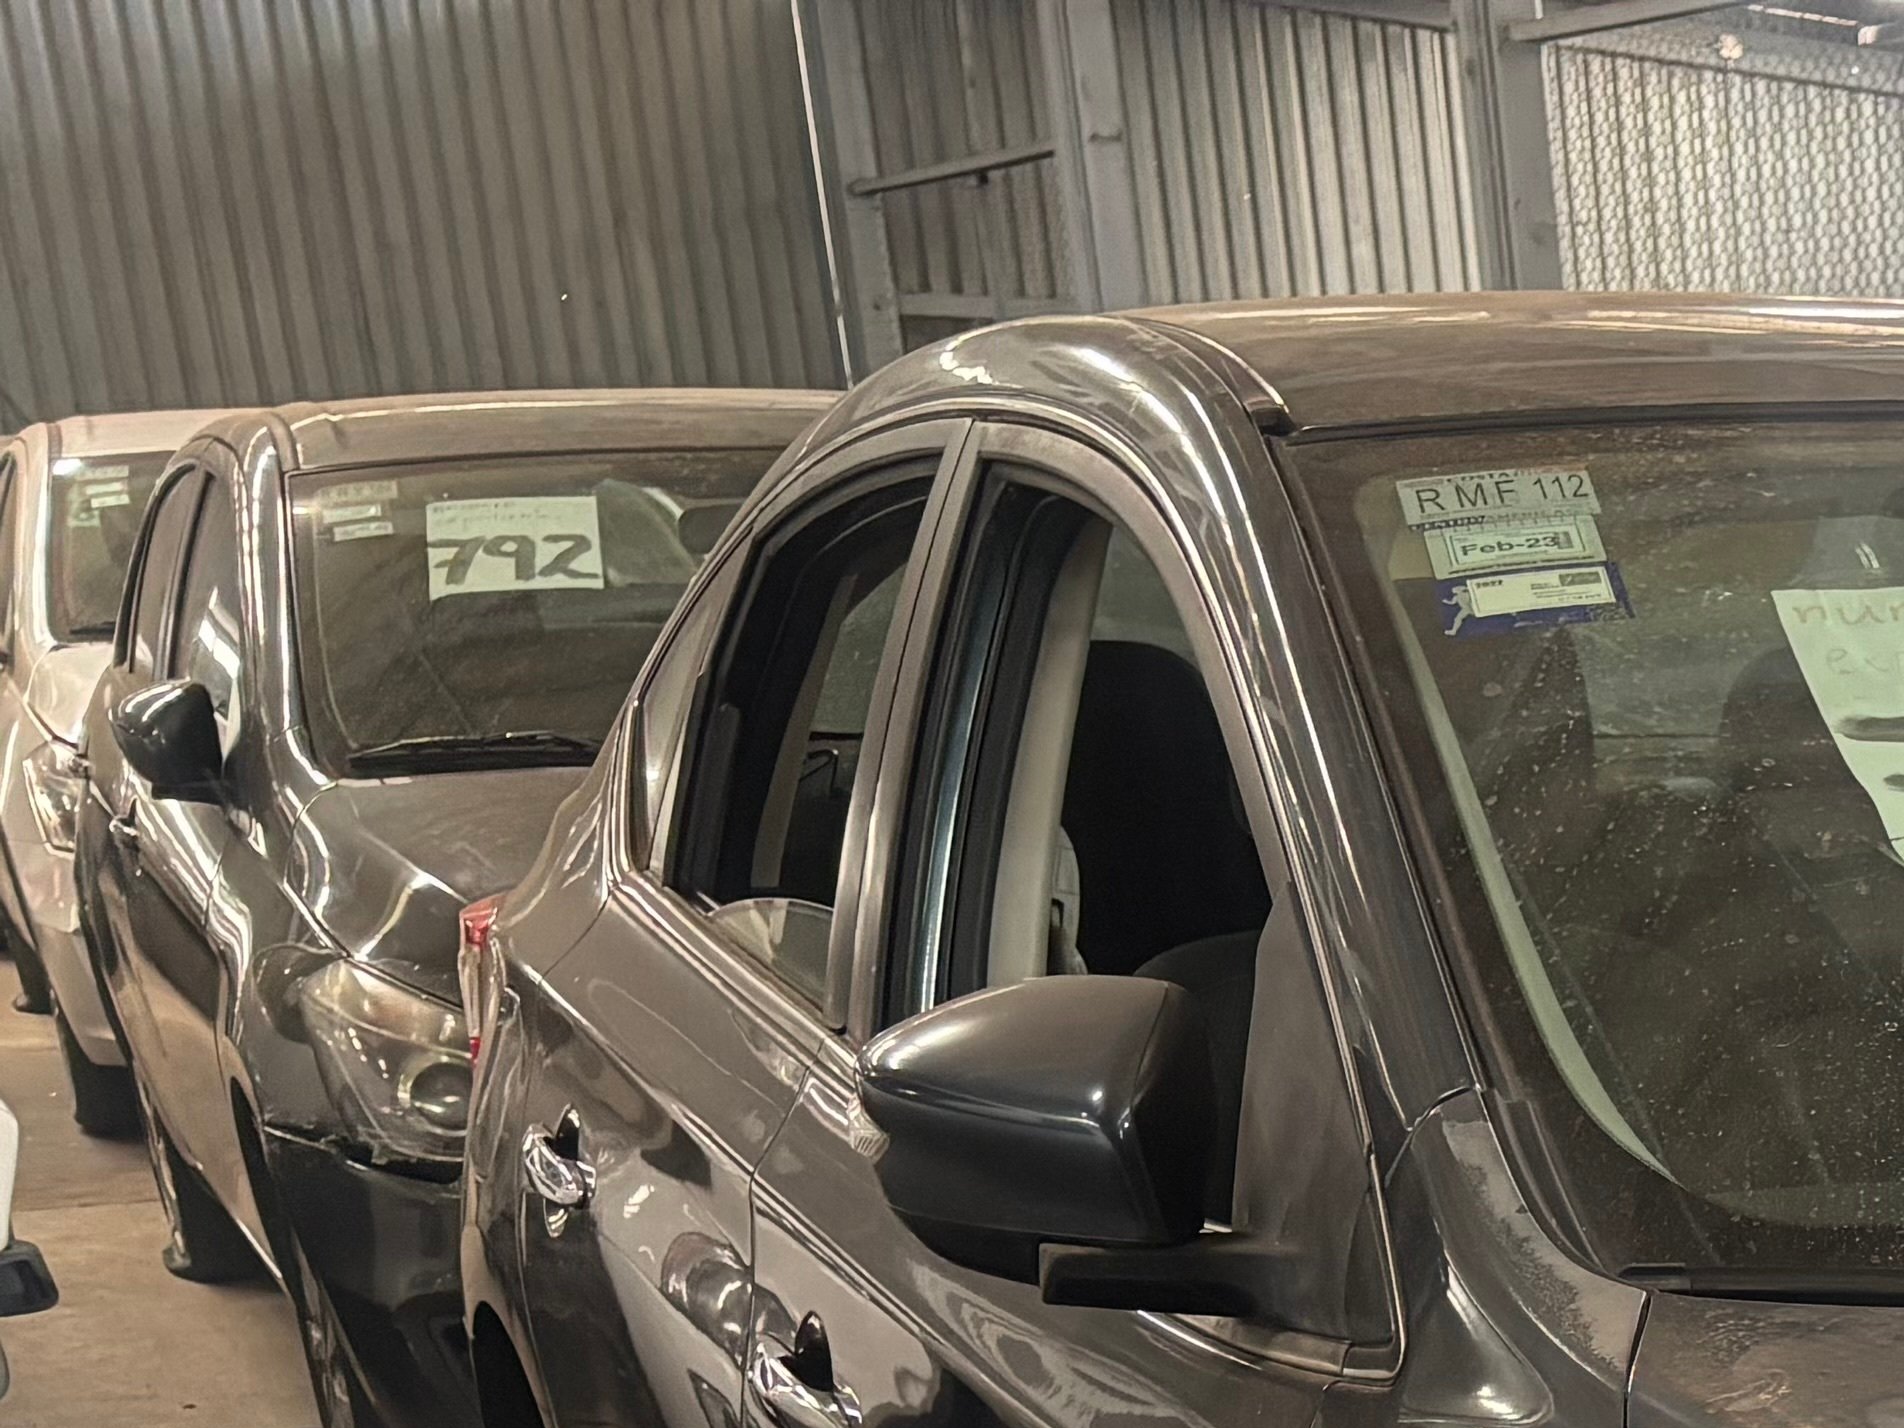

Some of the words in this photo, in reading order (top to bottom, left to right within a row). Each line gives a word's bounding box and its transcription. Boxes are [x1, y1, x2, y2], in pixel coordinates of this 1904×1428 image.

[1415, 479, 1516, 514] RMF
[1533, 474, 1589, 500] 112
[427, 533, 601, 586] 792
[1461, 535, 1558, 557] Feb-23
